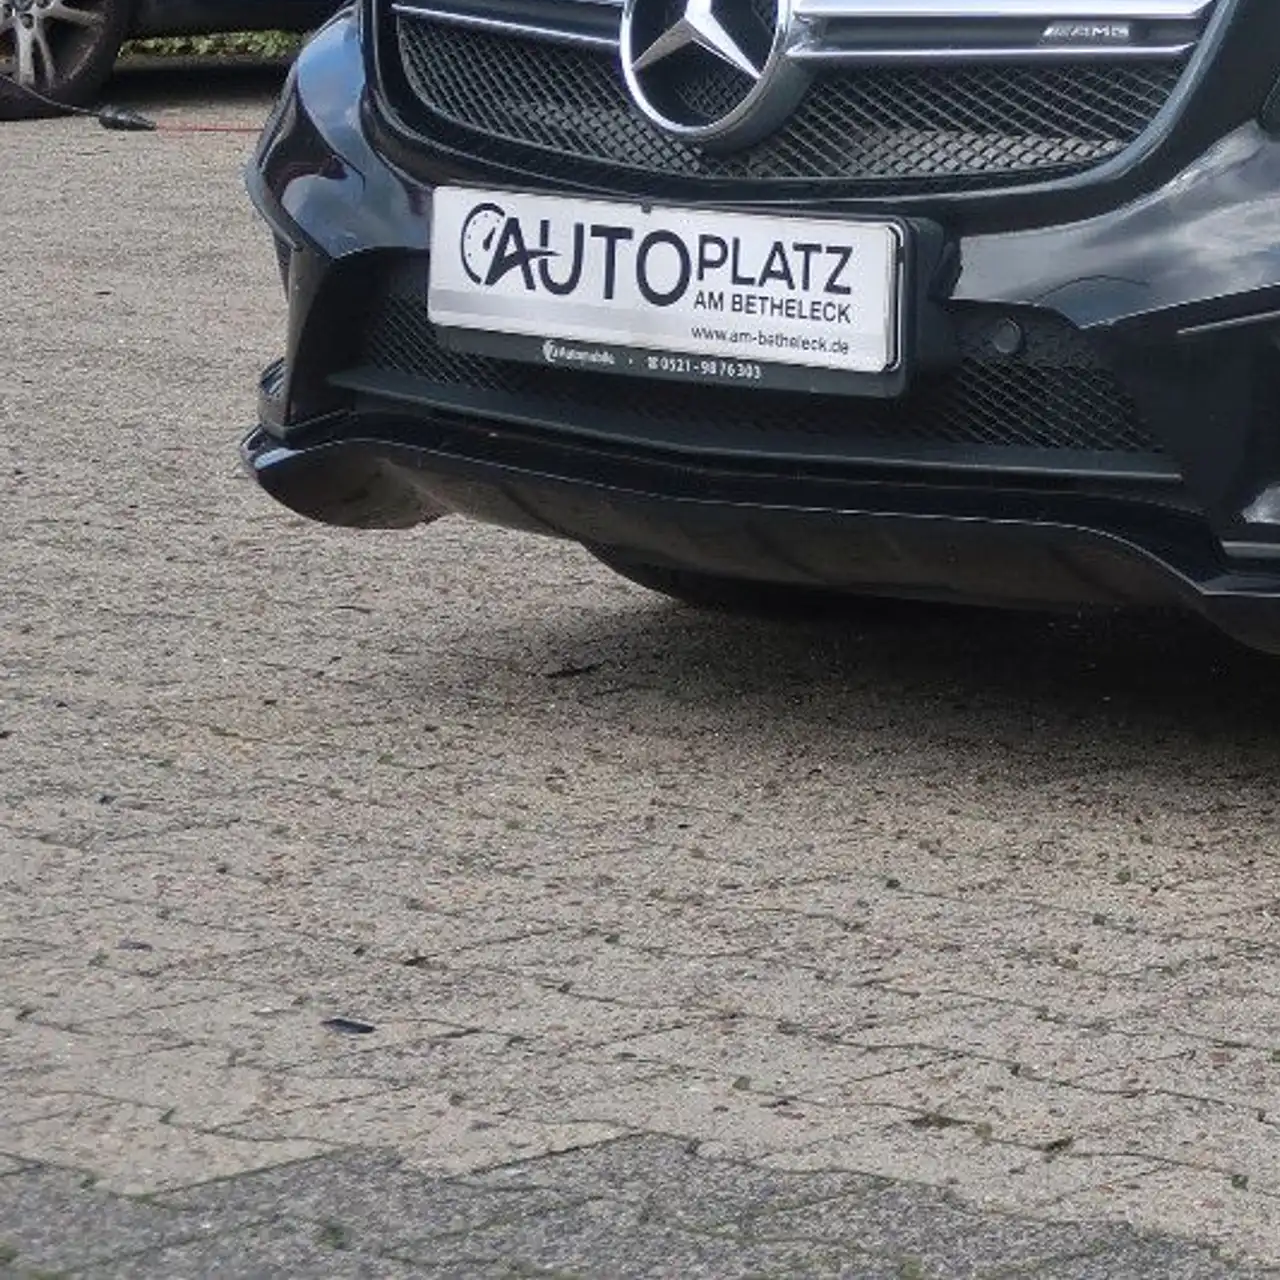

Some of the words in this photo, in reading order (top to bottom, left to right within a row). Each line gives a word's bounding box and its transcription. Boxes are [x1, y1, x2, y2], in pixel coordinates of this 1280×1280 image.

[693, 291, 725, 312] AM
[731, 293, 852, 324] BETHELECK
[691, 327, 849, 355] www.am-betheleck.de
